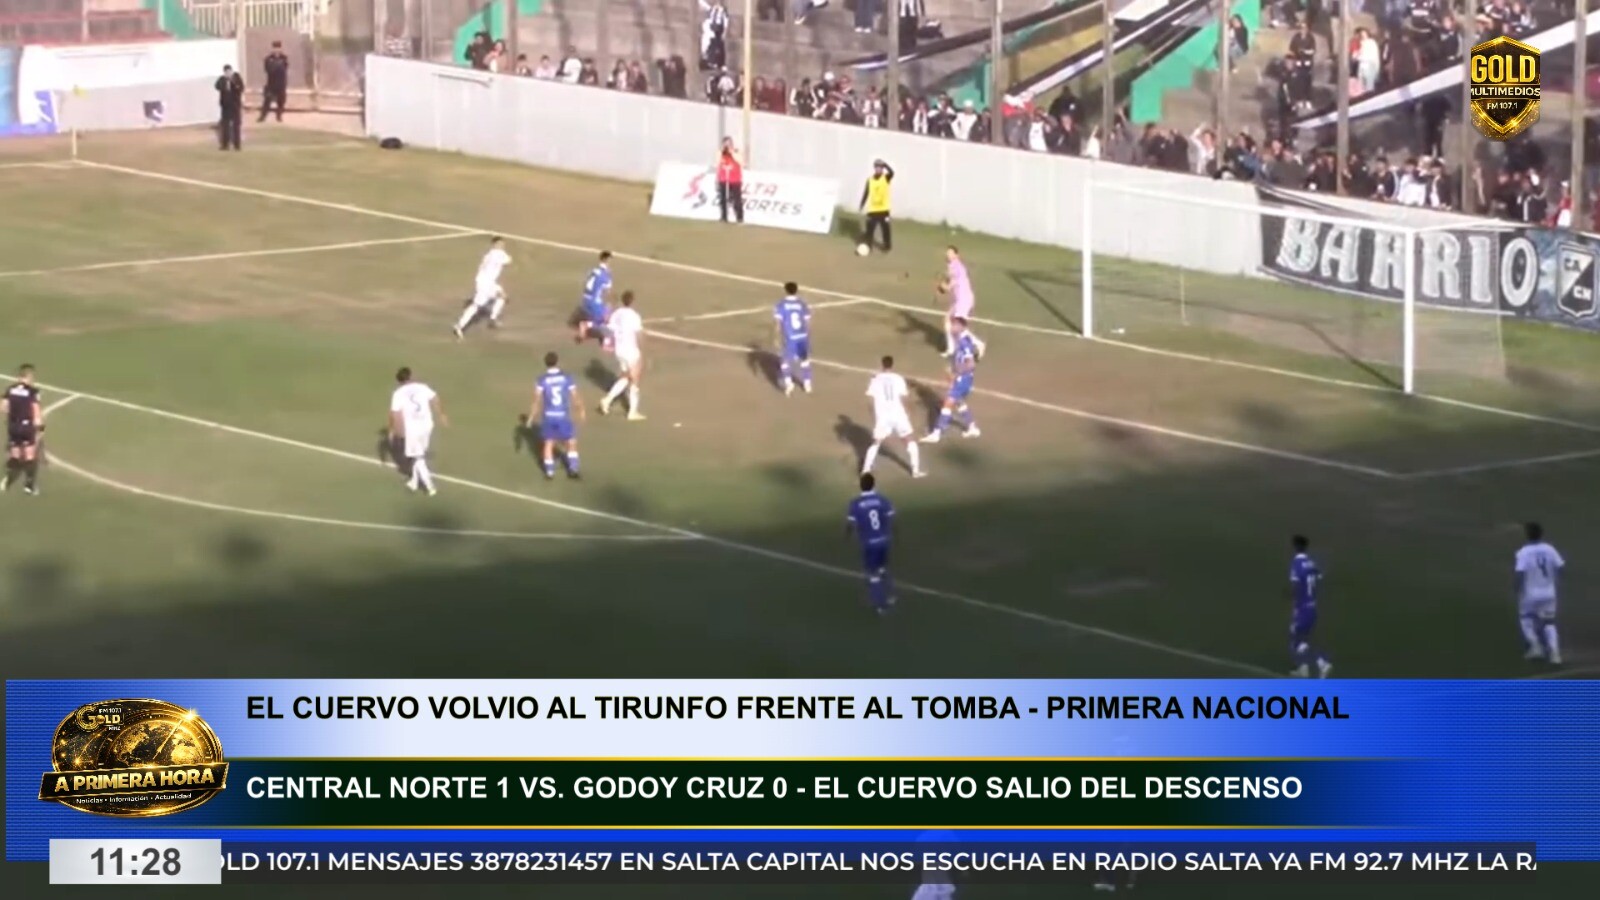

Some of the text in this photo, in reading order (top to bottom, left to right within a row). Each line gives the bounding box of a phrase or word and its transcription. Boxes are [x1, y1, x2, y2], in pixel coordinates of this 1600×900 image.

[1275, 216, 1538, 307] BARRIO
[868, 509, 881, 531] 8
[1536, 557, 1549, 578] 4
